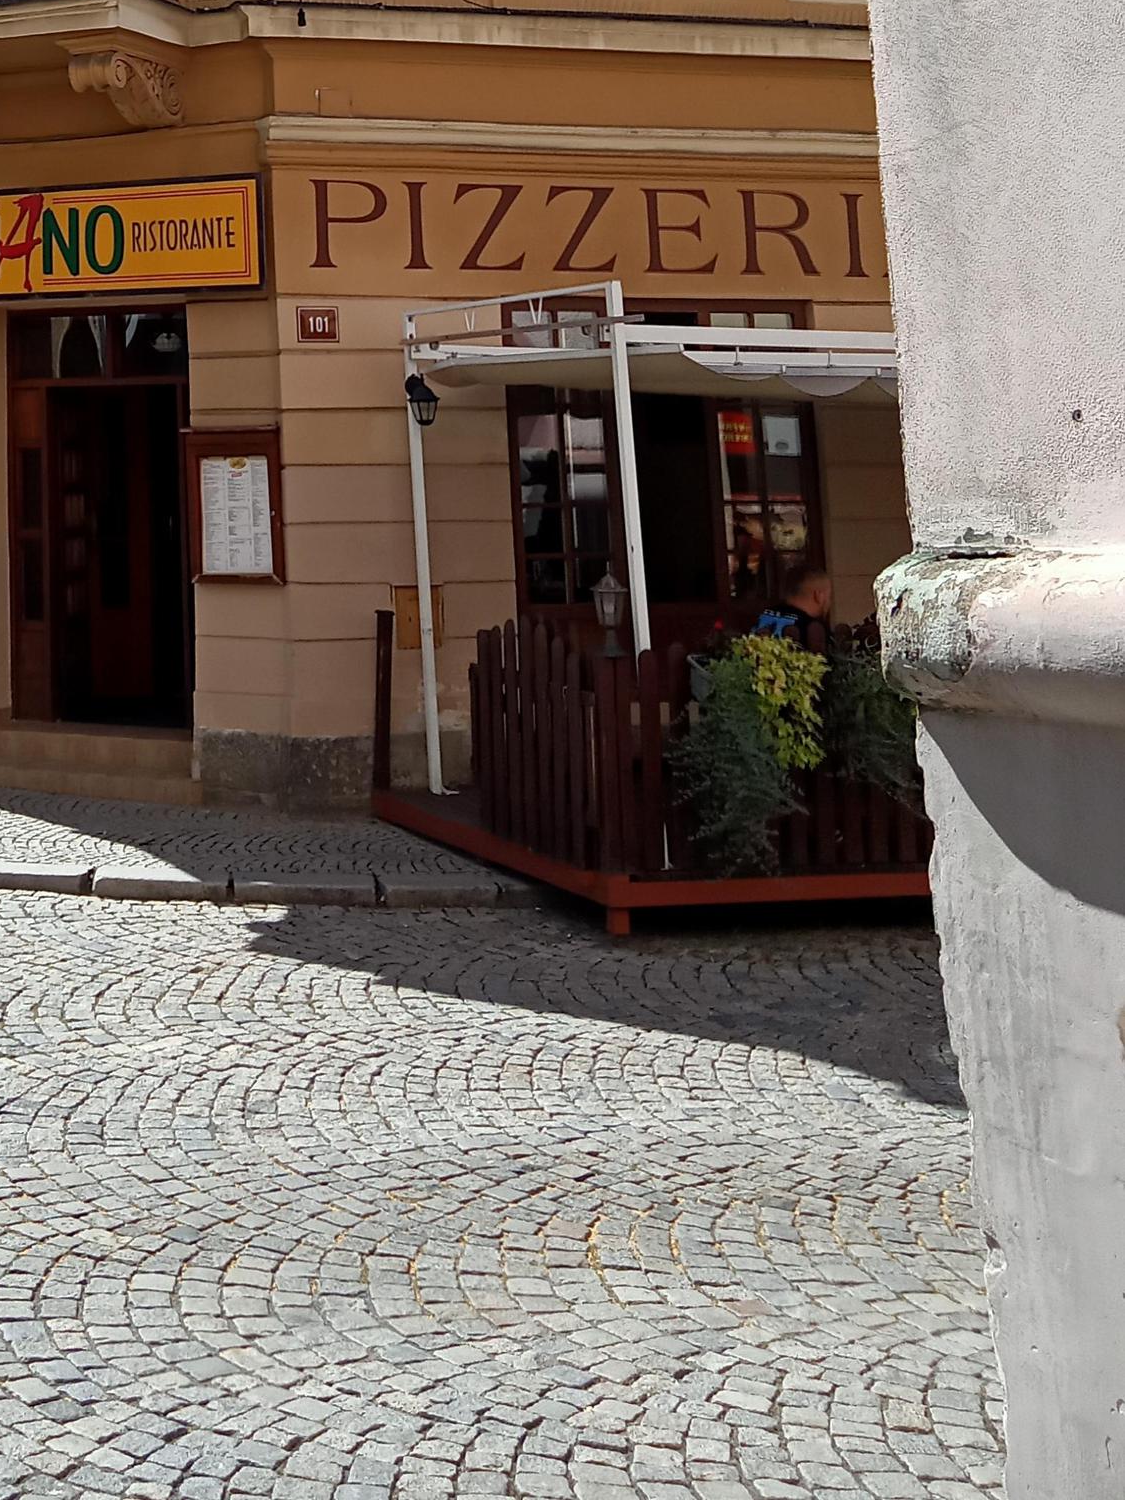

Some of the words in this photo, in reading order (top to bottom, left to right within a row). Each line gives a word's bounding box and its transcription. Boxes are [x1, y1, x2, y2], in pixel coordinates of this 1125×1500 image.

[131, 216, 236, 253] RISTORANTE
[308, 178, 890, 279] PIZZERI
[308, 316, 329, 333] 101
